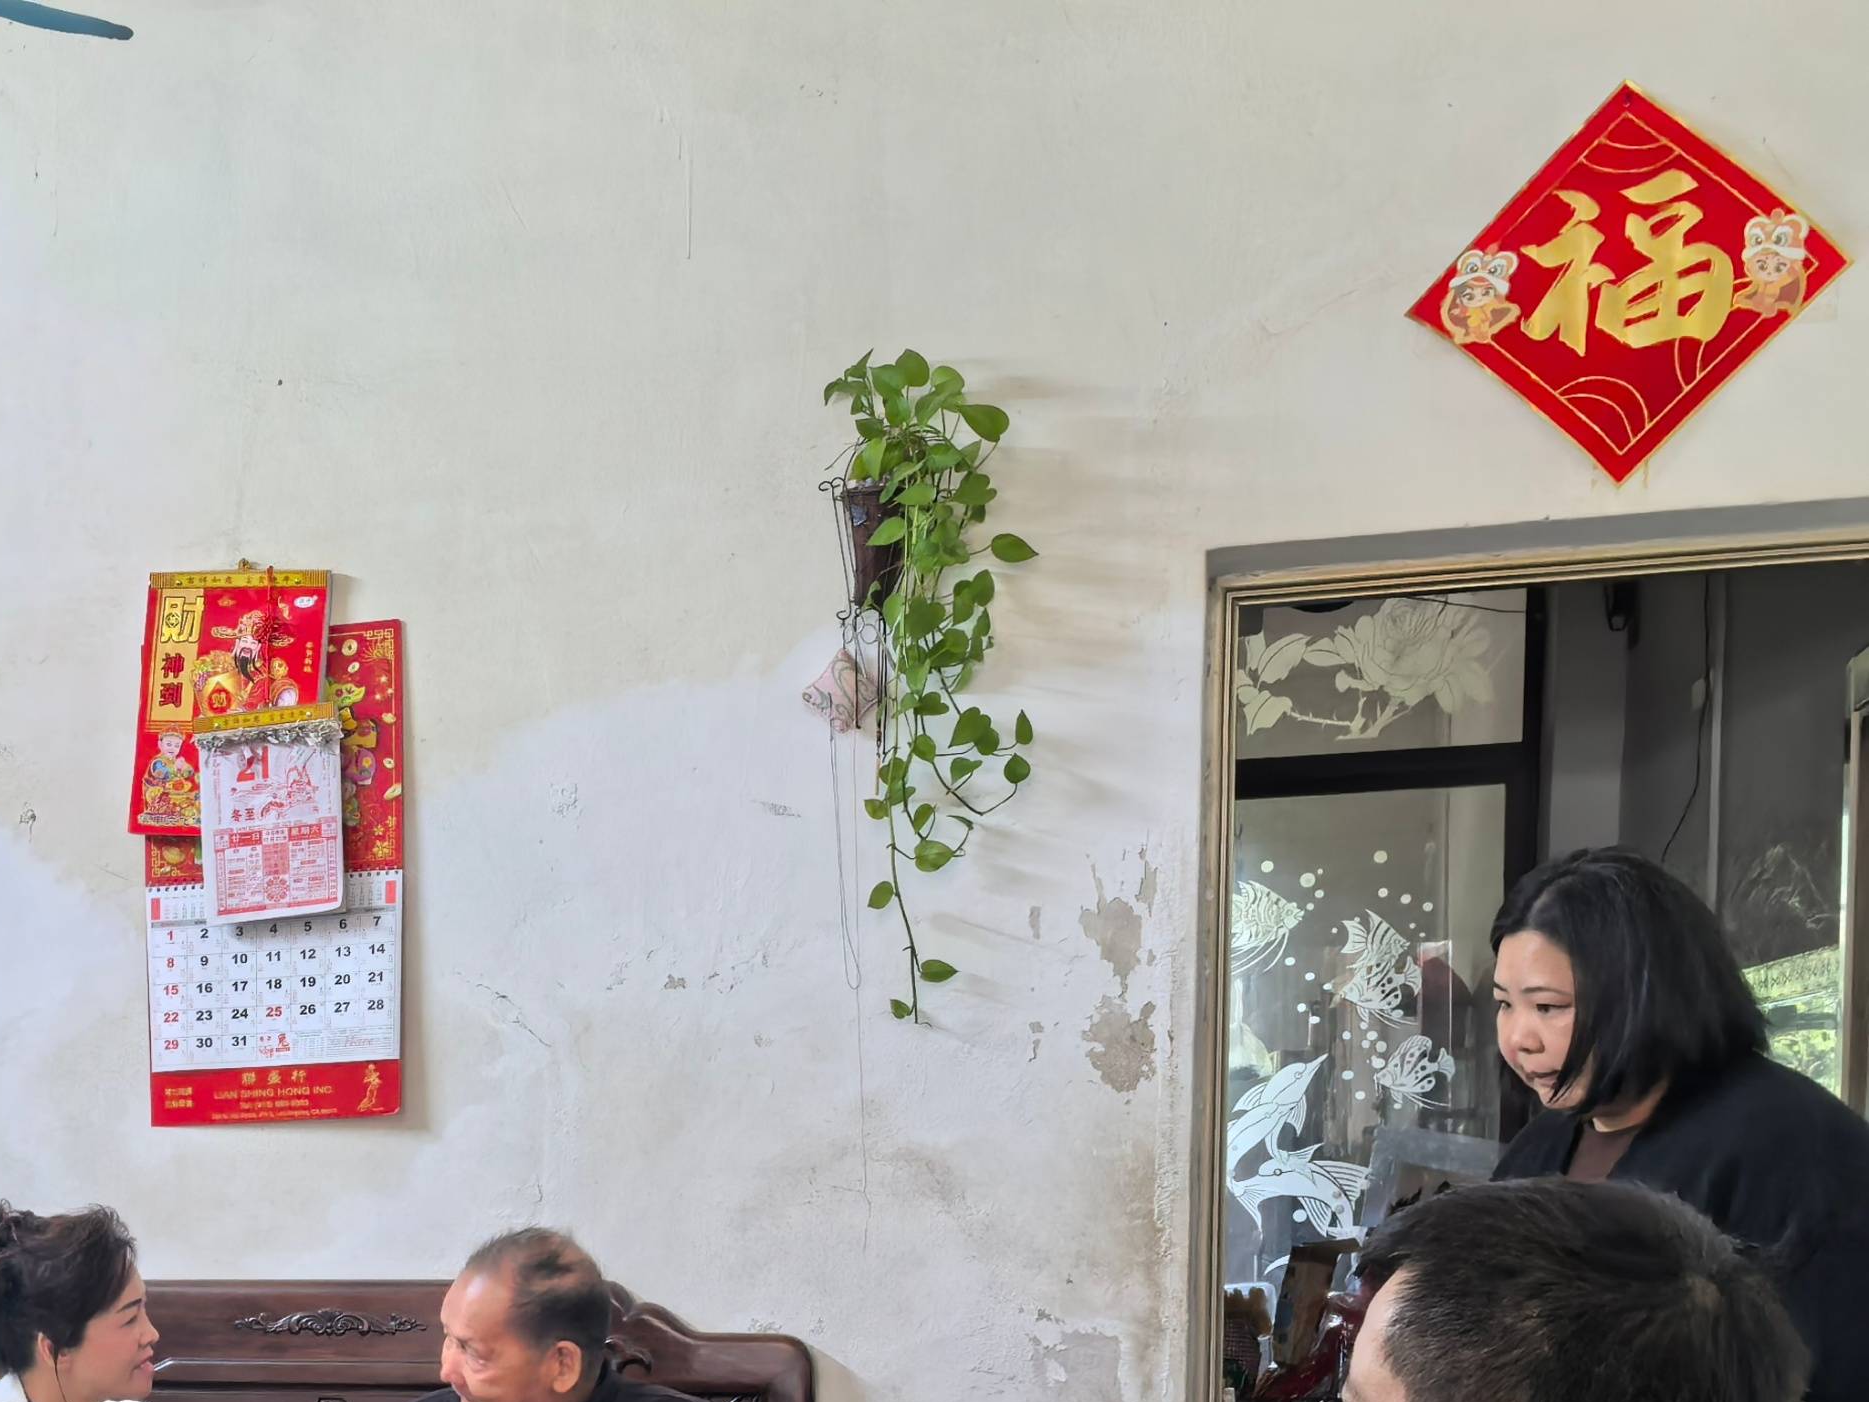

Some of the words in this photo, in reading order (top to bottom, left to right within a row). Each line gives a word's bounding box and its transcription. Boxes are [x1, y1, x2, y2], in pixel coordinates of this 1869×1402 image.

[1521, 169, 1733, 357] 福
[231, 808, 256, 822] 冬至
[167, 930, 173, 941] 1
[201, 928, 208, 938] 2
[236, 926, 243, 936] 3
[270, 922, 277, 933] 4
[304, 920, 312, 931] 5
[340, 919, 347, 929] 6
[373, 916, 381, 926] 7
[167, 958, 174, 968] 8
[201, 956, 208, 966] 9
[232, 954, 247, 964] 10
[266, 951, 280, 961] 11
[300, 949, 315, 959] 12
[336, 946, 350, 956] 13
[369, 944, 385, 954] 14
[164, 985, 178, 995] 15
[197, 983, 212, 993] 16
[232, 981, 248, 991] 17
[266, 979, 282, 989] 18
[300, 977, 315, 987] 19
[335, 974, 350, 985] 20
[368, 972, 383, 982] 21
[164, 1012, 178, 1023] 22
[196, 1010, 212, 1021] 23
[232, 1009, 248, 1019] 24
[266, 1006, 282, 1017] 25
[300, 1004, 316, 1015] 26
[335, 1002, 350, 1013] 27
[368, 1000, 384, 1010] 28
[165, 1040, 178, 1049] 29
[197, 1038, 212, 1048] 30
[232, 1036, 246, 1046] 31
